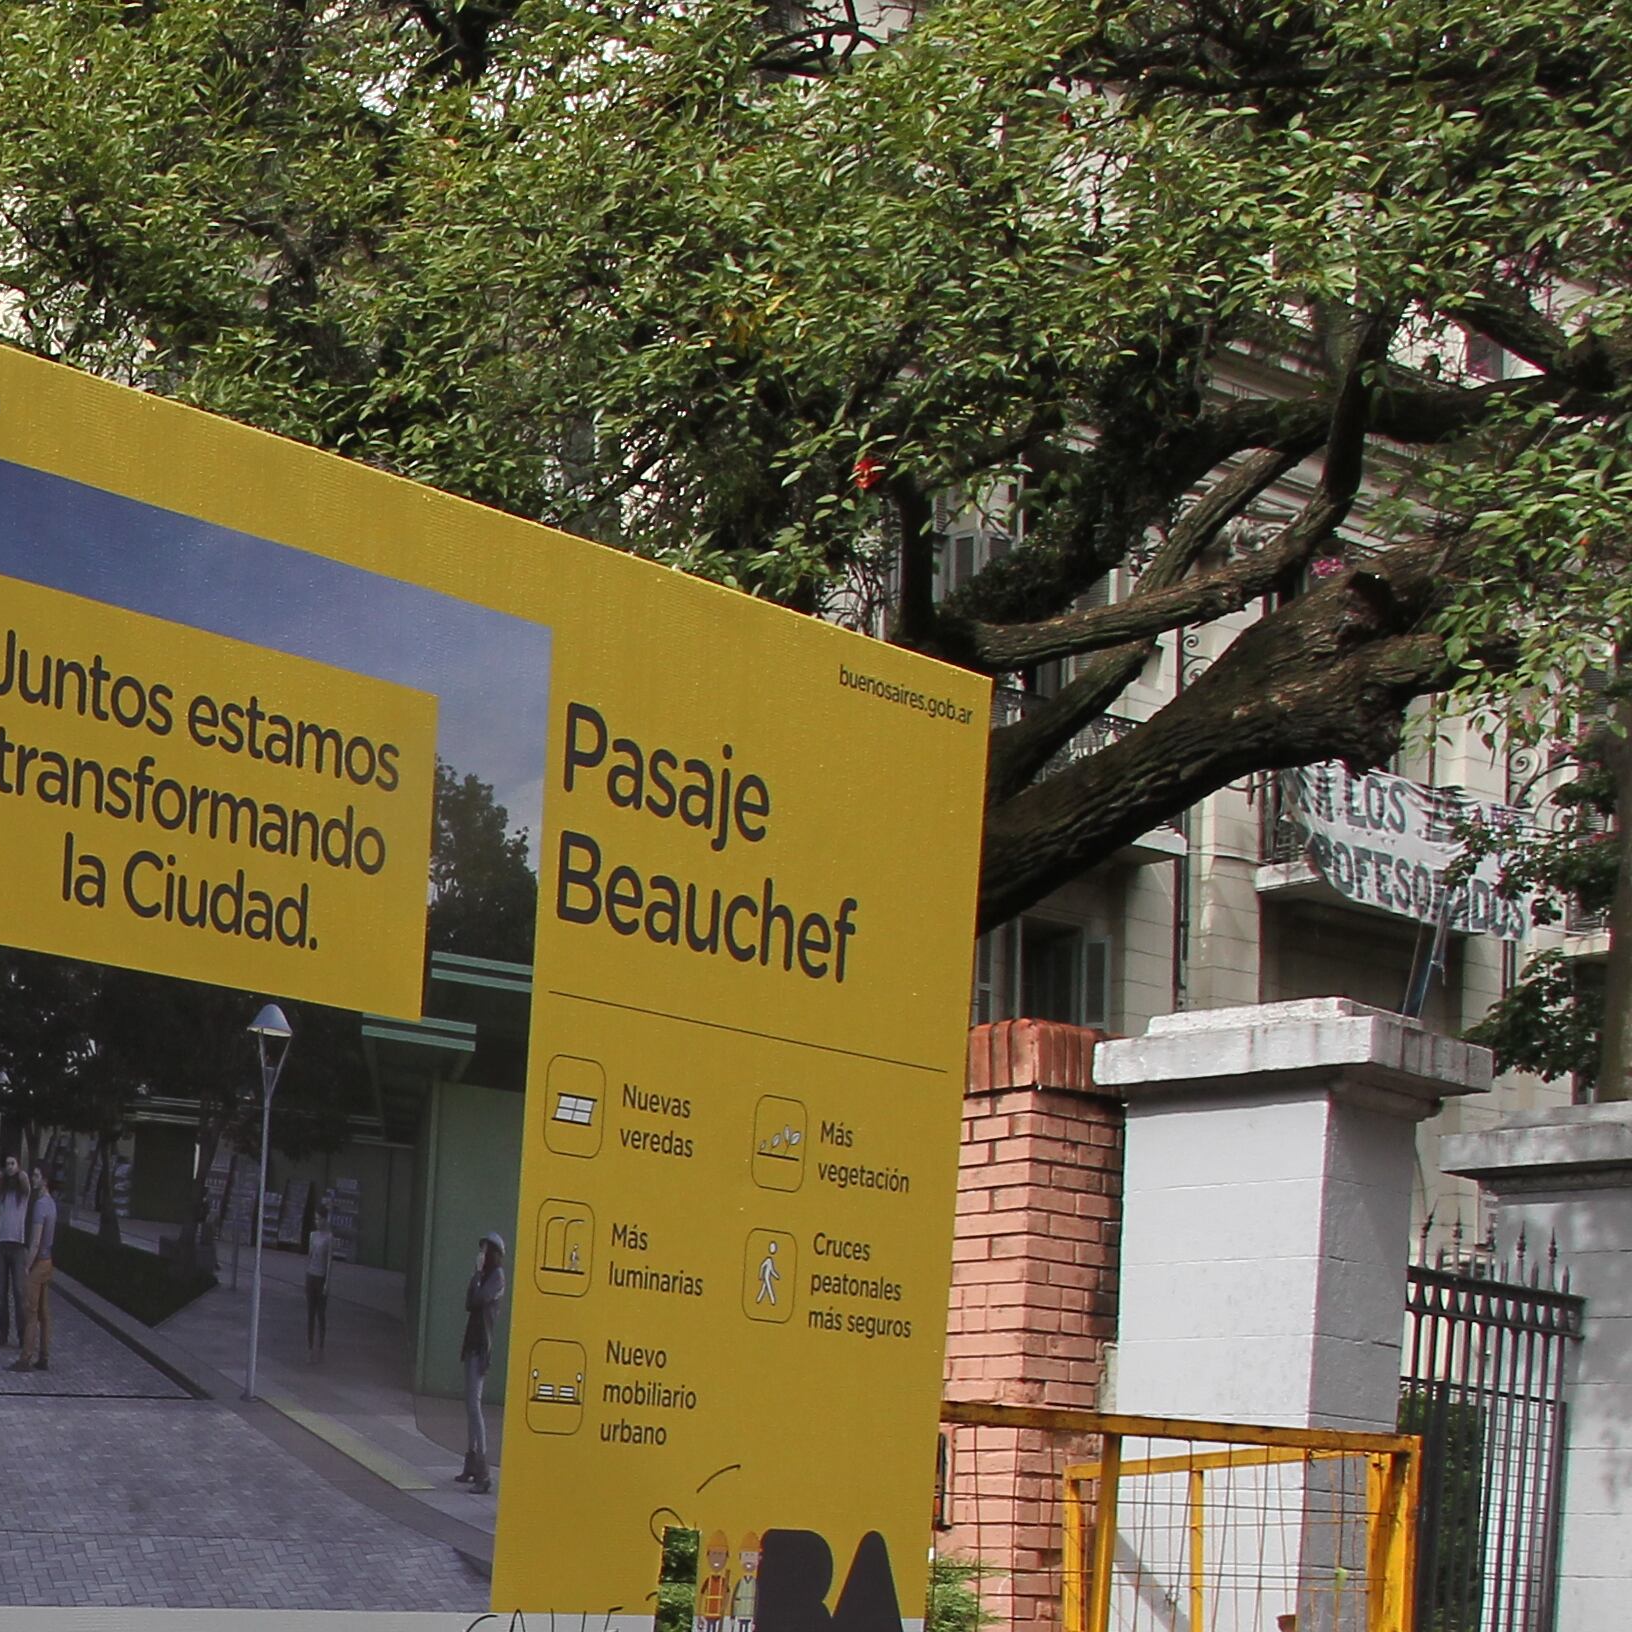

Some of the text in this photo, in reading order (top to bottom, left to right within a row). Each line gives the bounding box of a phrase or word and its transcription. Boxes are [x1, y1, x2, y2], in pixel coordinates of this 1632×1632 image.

[838, 664, 973, 726] buenosaires.gob.ar
[186, 694, 400, 793] estamos
[562, 700, 771, 853] Pasaje
[61, 831, 320, 952] la Ciudad.
[555, 829, 859, 984] Beauchef
[621, 1083, 692, 1119] Nuevas
[619, 1126, 694, 1159] veredas
[819, 1120, 854, 1149] Más
[817, 1160, 911, 1194] vegetación
[610, 1222, 649, 1252] Más
[812, 1232, 872, 1263] Cruces
[608, 1261, 704, 1298] luminarias
[810, 1270, 903, 1302] peatonales
[807, 1305, 913, 1340] más seguros
[605, 1339, 667, 1369] Nuevo
[602, 1380, 698, 1411] mobiliario
[600, 1421, 668, 1447] urbano
